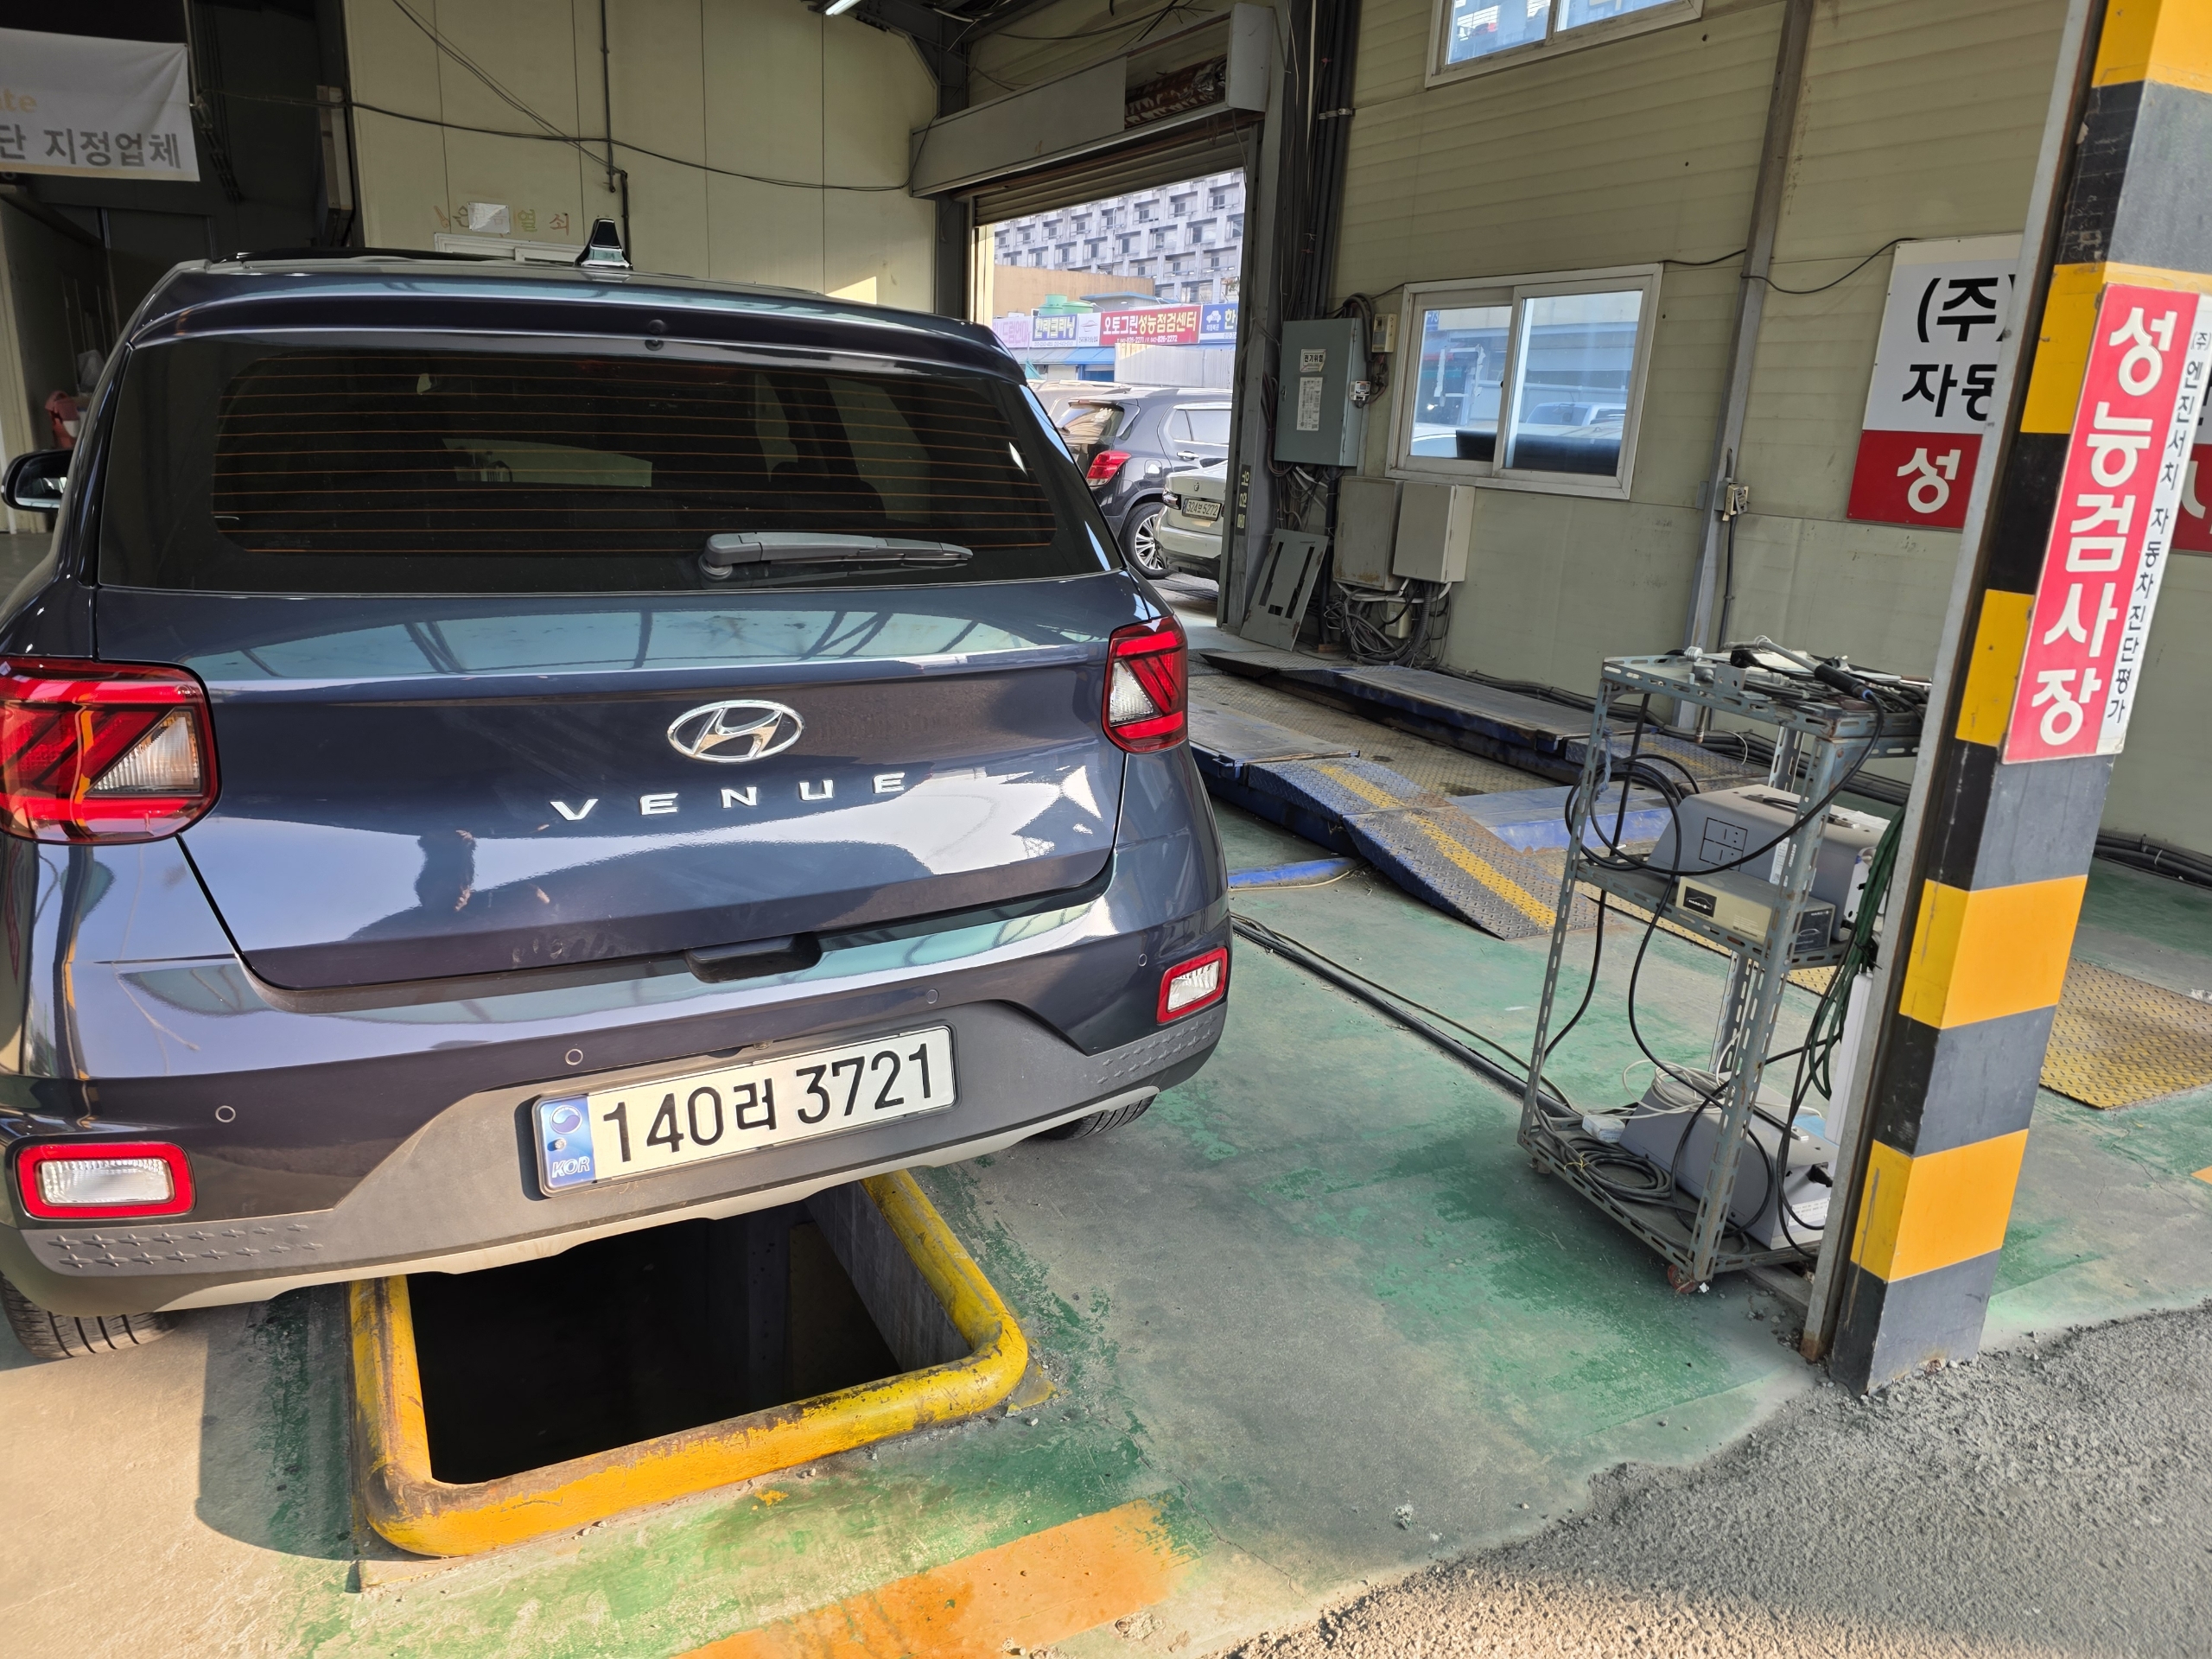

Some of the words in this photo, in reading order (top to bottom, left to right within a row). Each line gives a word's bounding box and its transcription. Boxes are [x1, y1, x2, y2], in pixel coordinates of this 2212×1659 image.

[0, 89, 37, 113] te
[44, 128, 181, 168] 지정업체
[1304, 354, 1324, 363] 전기위험
[1897, 448, 1961, 514] 성
[1186, 501, 1203, 514] 324보
[1202, 504, 1218, 516] 5272
[2031, 307, 2177, 745] 성능검사장
[2107, 507, 2169, 723] 자동차진단평가
[550, 772, 906, 821] VENUE
[603, 1077, 777, 1162] 140러
[796, 1043, 933, 1124] 3721
[551, 1155, 590, 1179] KOR
